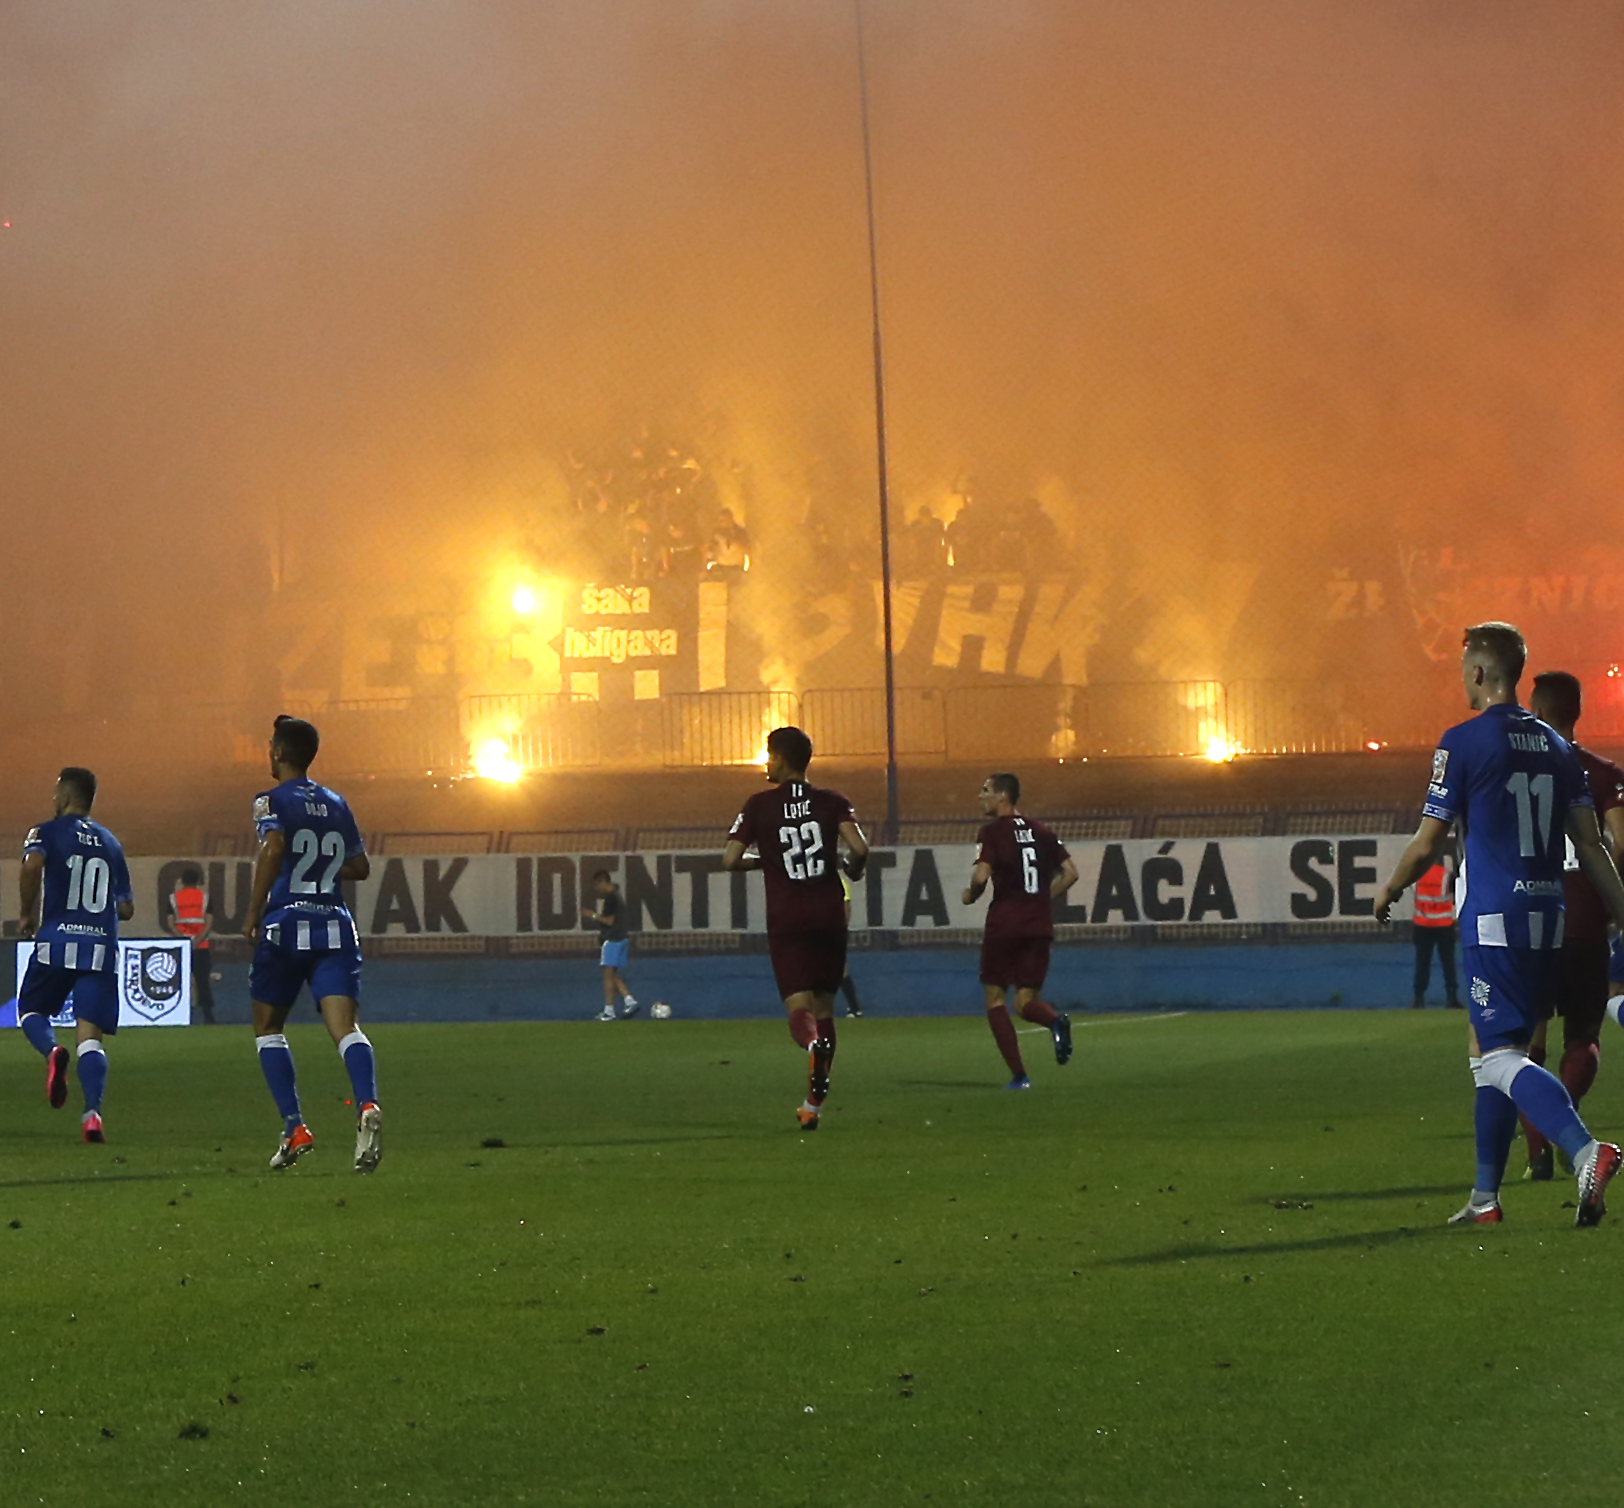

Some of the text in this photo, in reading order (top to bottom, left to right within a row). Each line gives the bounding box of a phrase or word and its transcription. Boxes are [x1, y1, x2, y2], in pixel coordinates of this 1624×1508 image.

[289, 828, 346, 895] 22
[778, 820, 826, 880] 22
[1022, 847, 1040, 894] 6
[66, 854, 110, 914] 10
[1055, 841, 1239, 924] LAĆA
[1289, 838, 1379, 921] SE
[56, 922, 108, 936] ADMIRAL
